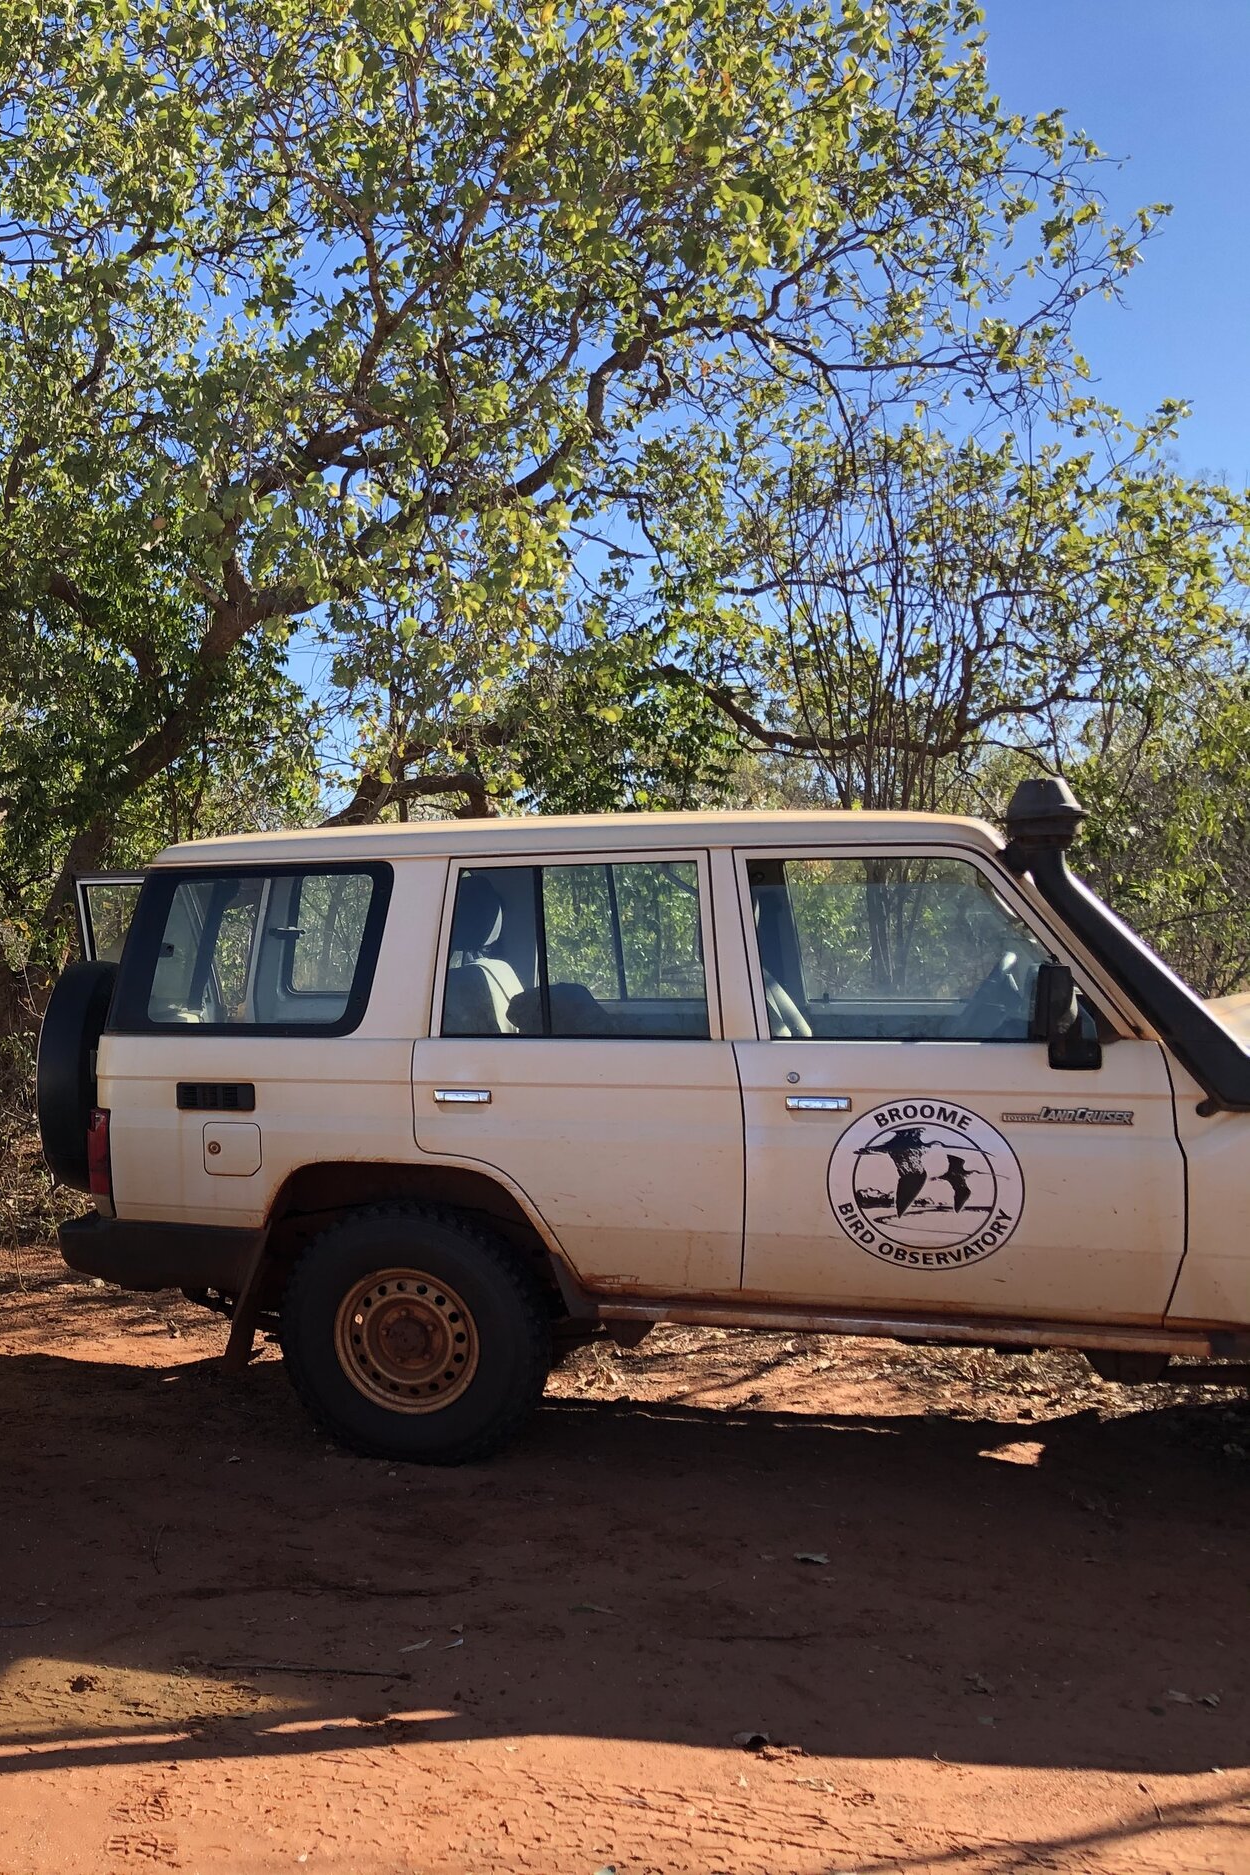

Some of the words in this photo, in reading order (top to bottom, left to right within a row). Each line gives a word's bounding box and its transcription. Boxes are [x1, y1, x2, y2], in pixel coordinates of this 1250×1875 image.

[873, 1104, 973, 1131] BROOME
[1003, 1114, 1039, 1122] TOYOTA
[838, 1202, 876, 1245] BIRD
[878, 1208, 1013, 1266] OBSERVATORY
